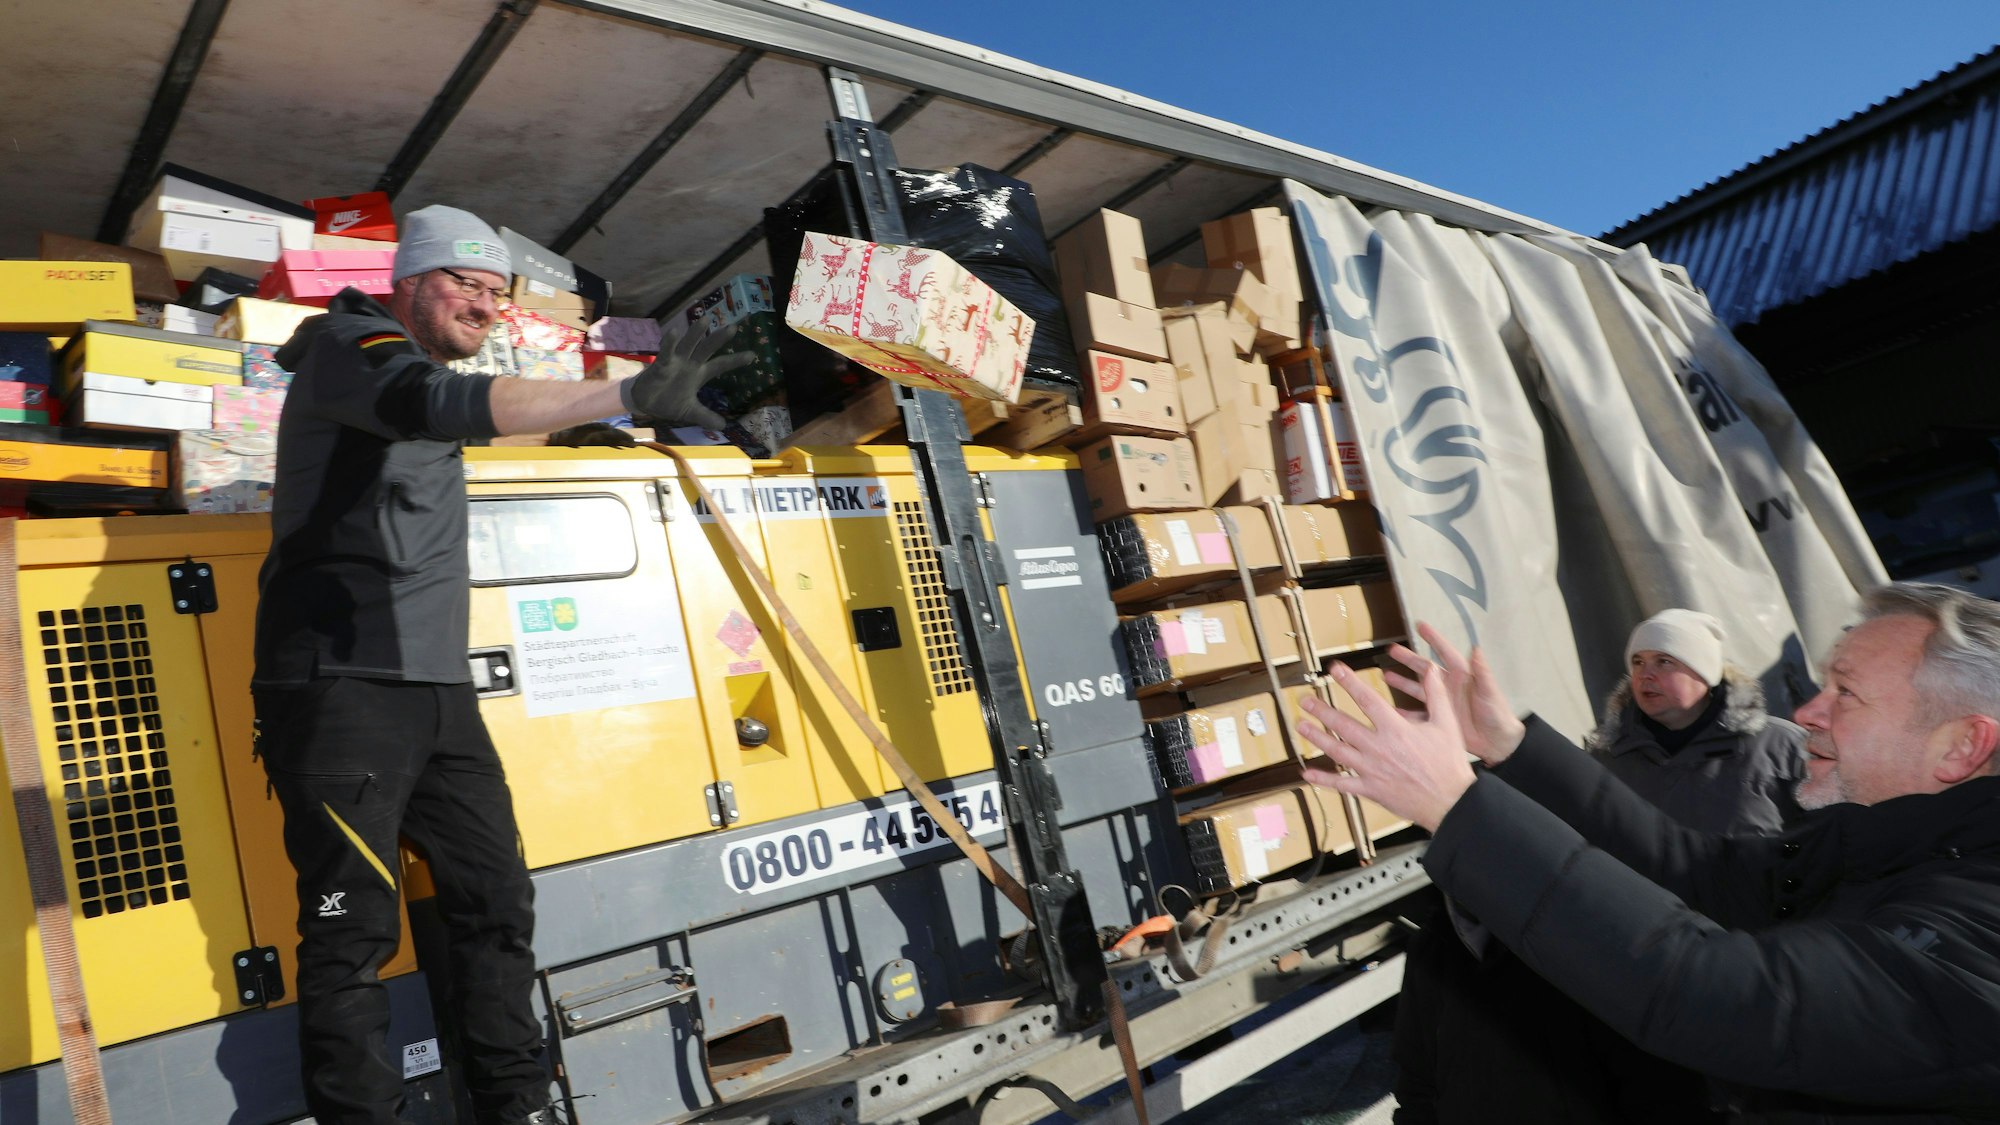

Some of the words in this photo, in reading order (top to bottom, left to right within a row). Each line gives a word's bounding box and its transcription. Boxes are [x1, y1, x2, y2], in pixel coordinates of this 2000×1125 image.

[333, 209, 362, 225] NIKE
[45, 269, 117, 281] PACKSET
[526, 654, 576, 669] Bergisch
[578, 649, 631, 664] Gladbach
[1045, 678, 1097, 707] QAS
[1099, 673, 1126, 697] 60
[408, 1044, 427, 1057] 450
